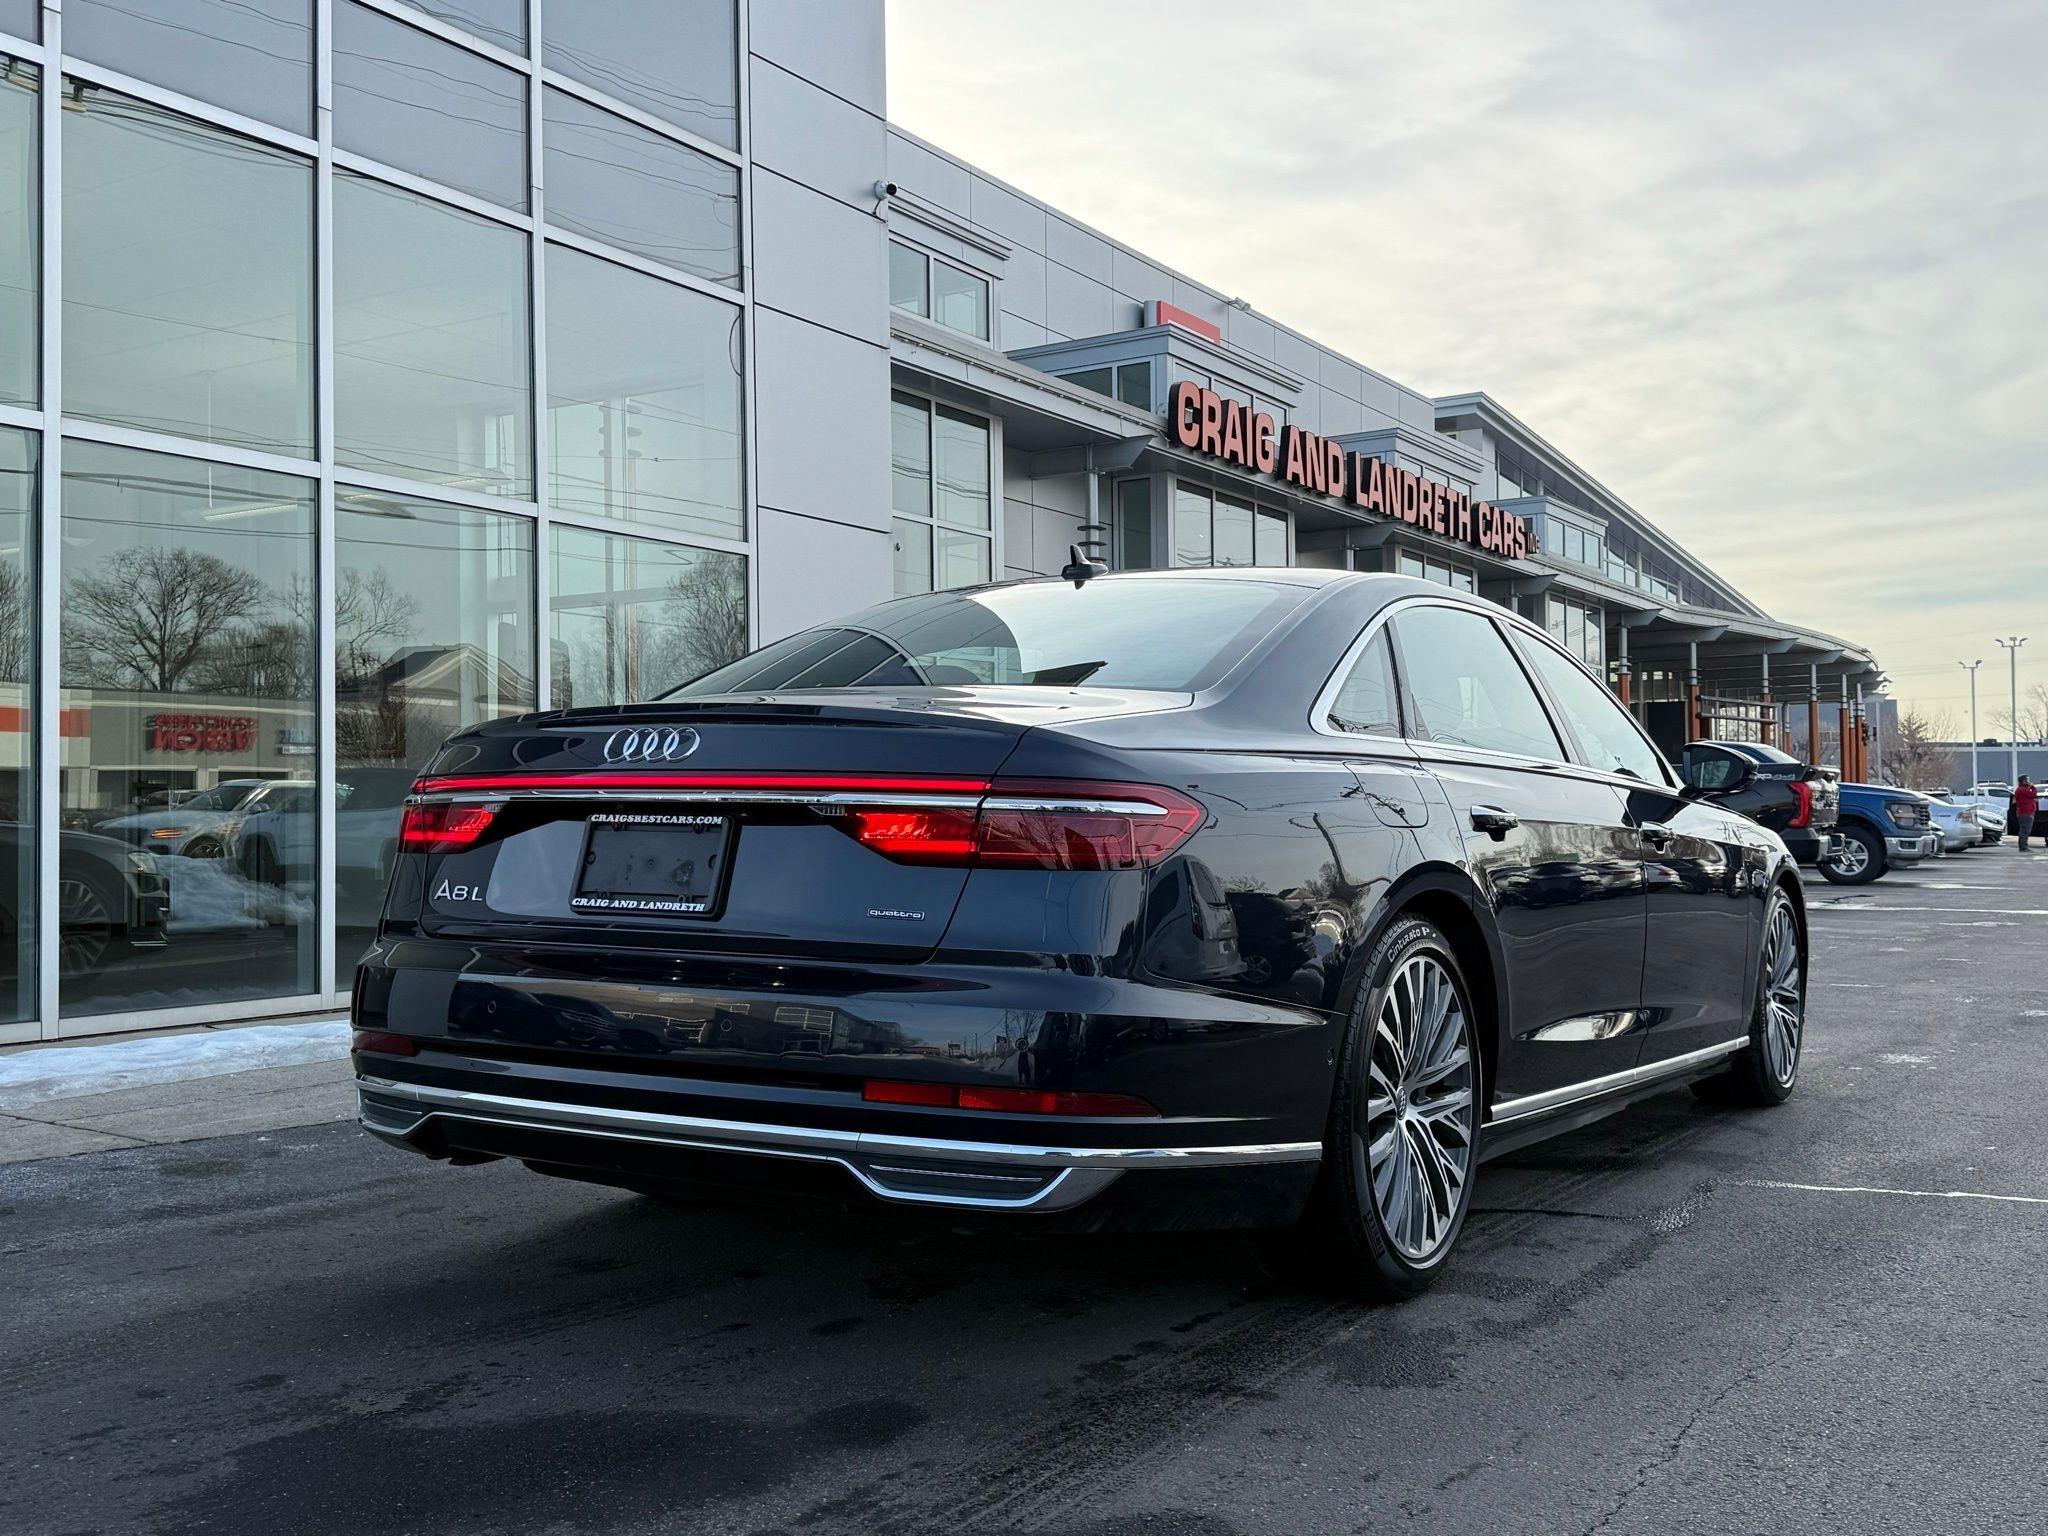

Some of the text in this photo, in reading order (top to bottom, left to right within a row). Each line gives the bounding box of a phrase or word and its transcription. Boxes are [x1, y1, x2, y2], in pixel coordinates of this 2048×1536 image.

[1174, 380, 1275, 474] CRAIG
[1283, 424, 1345, 498] AND
[1353, 451, 1472, 544] LANDRETH
[1477, 500, 1527, 560] CARS
[590, 814, 723, 825] CRAIGSBESTCARS.COM
[571, 897, 706, 912] CRAIG AND LANDRETH
[868, 908, 922, 919] quattro
